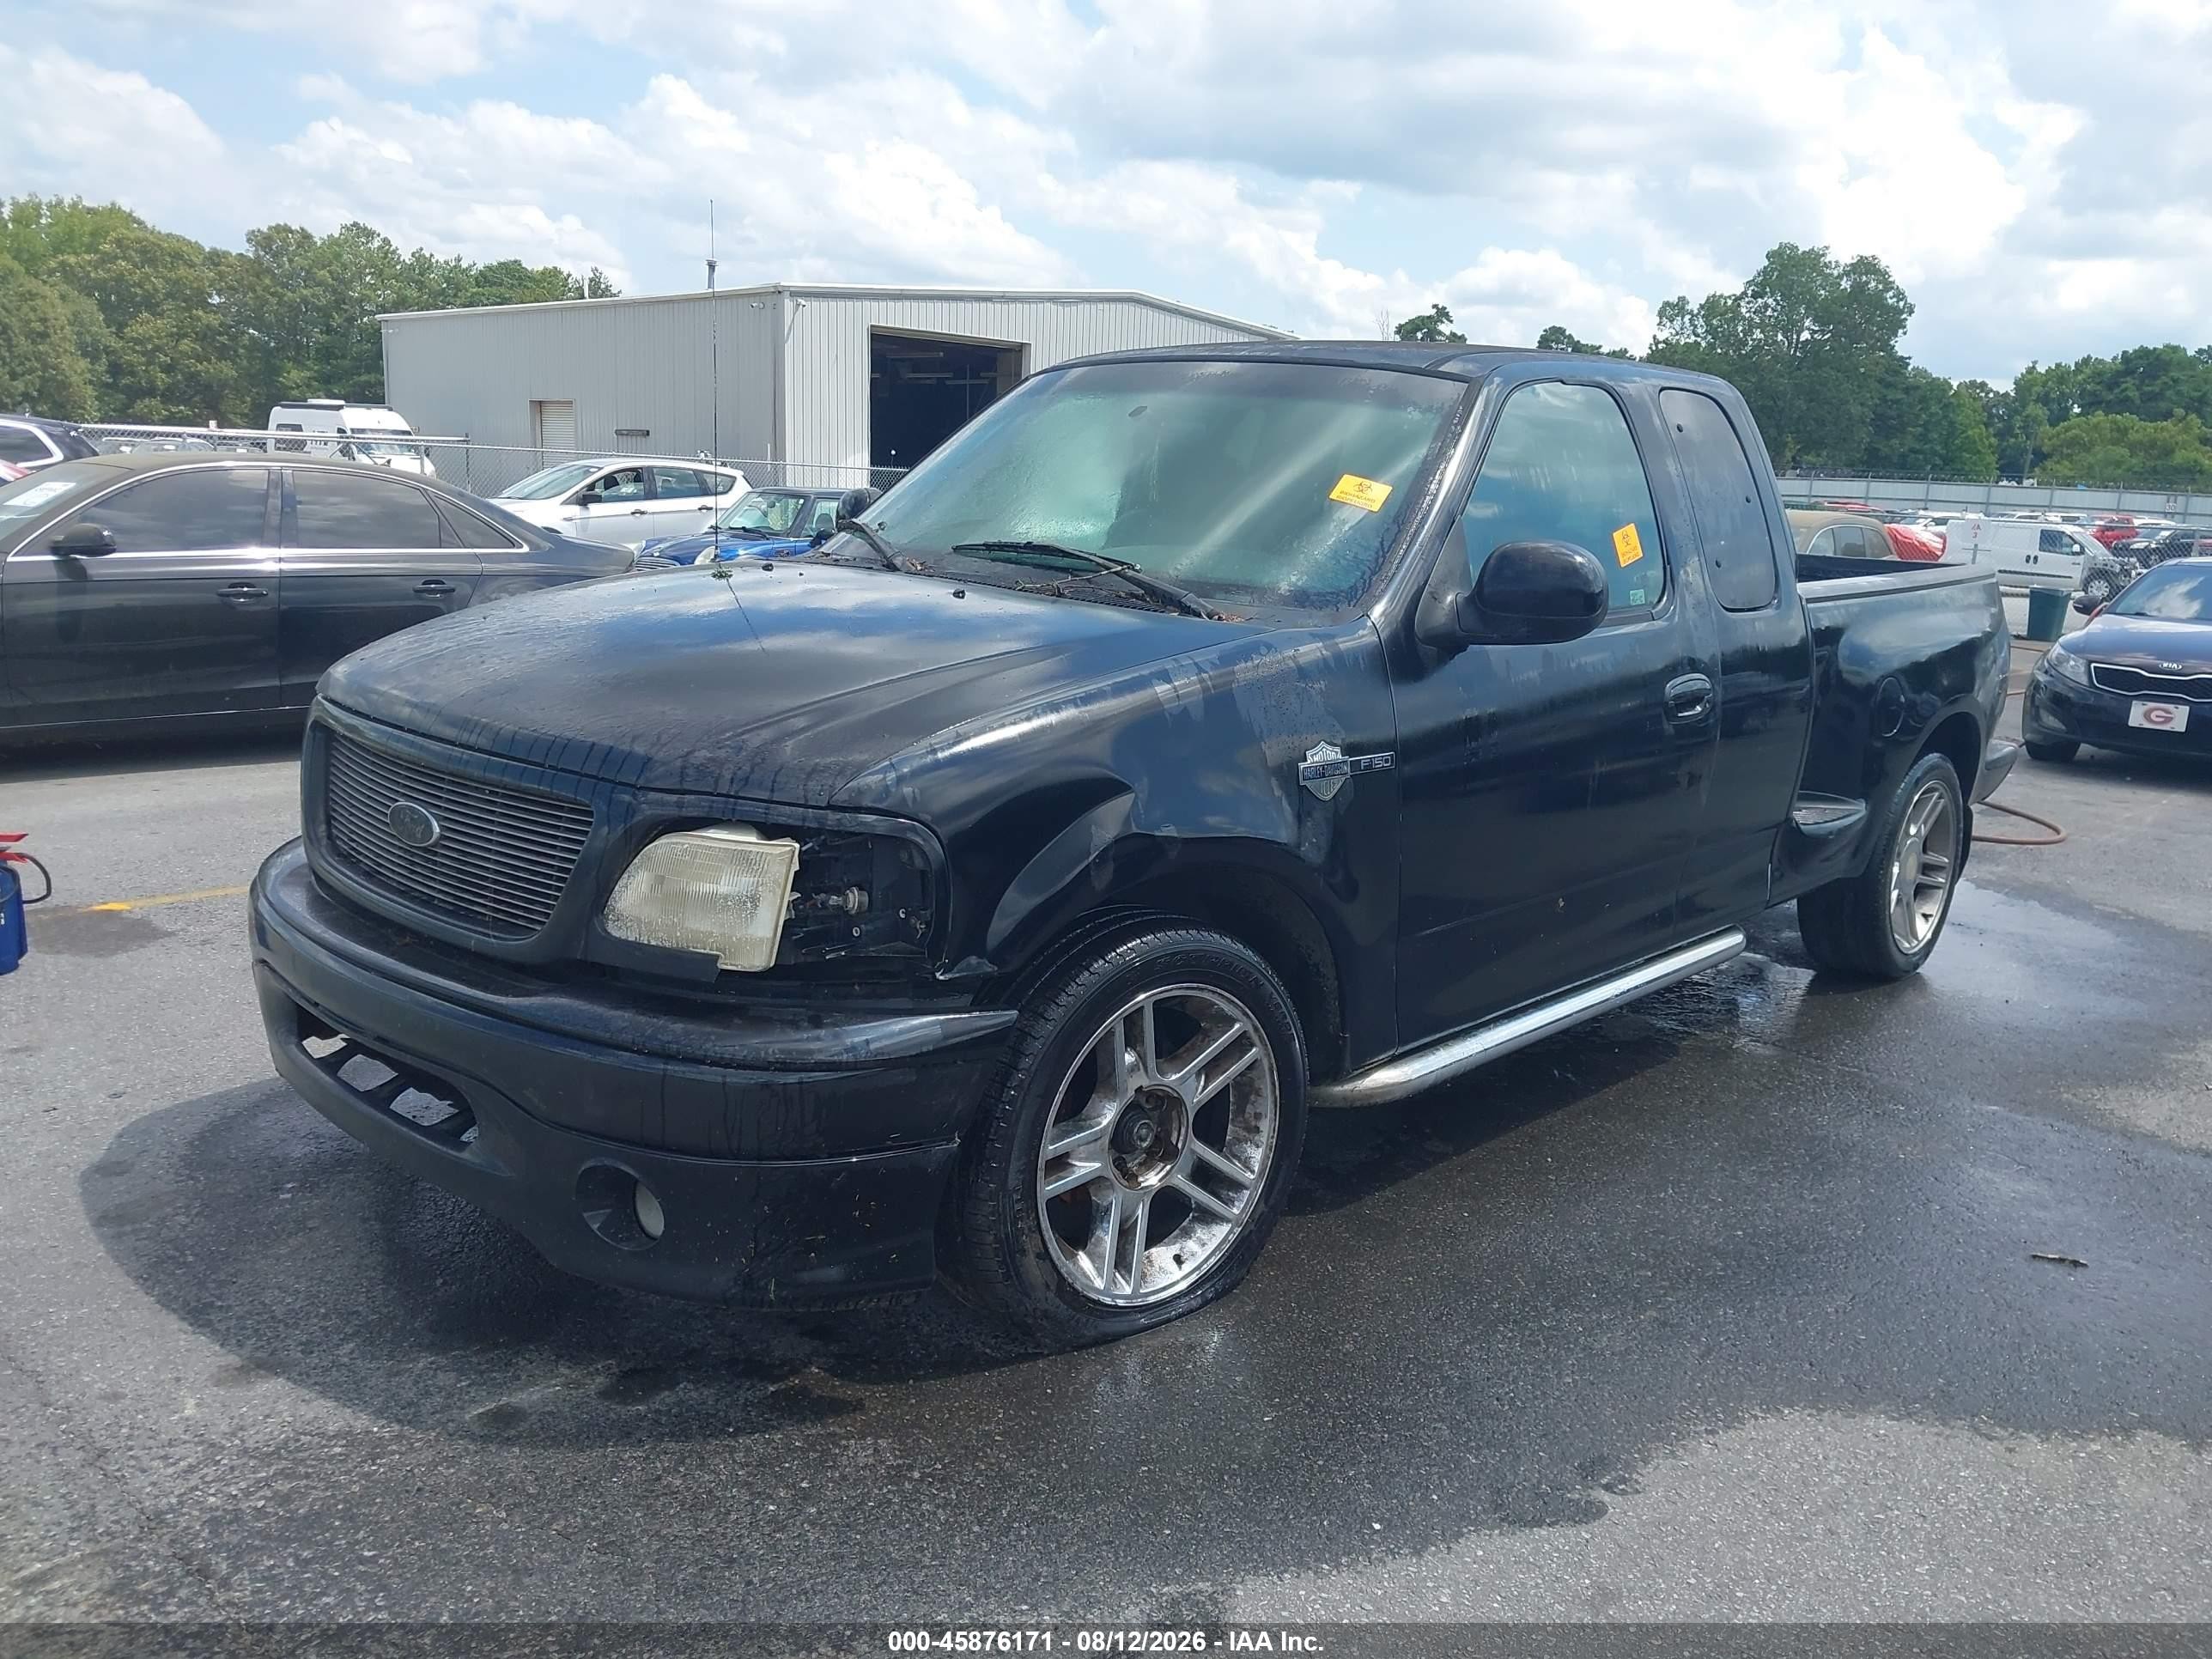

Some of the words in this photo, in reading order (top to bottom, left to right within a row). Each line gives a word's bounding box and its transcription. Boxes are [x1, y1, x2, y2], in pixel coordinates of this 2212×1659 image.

[2143, 706, 2175, 726] G
[1303, 761, 1347, 781] HARLEY-DAVIDSON
[1360, 756, 1391, 770] F-150
